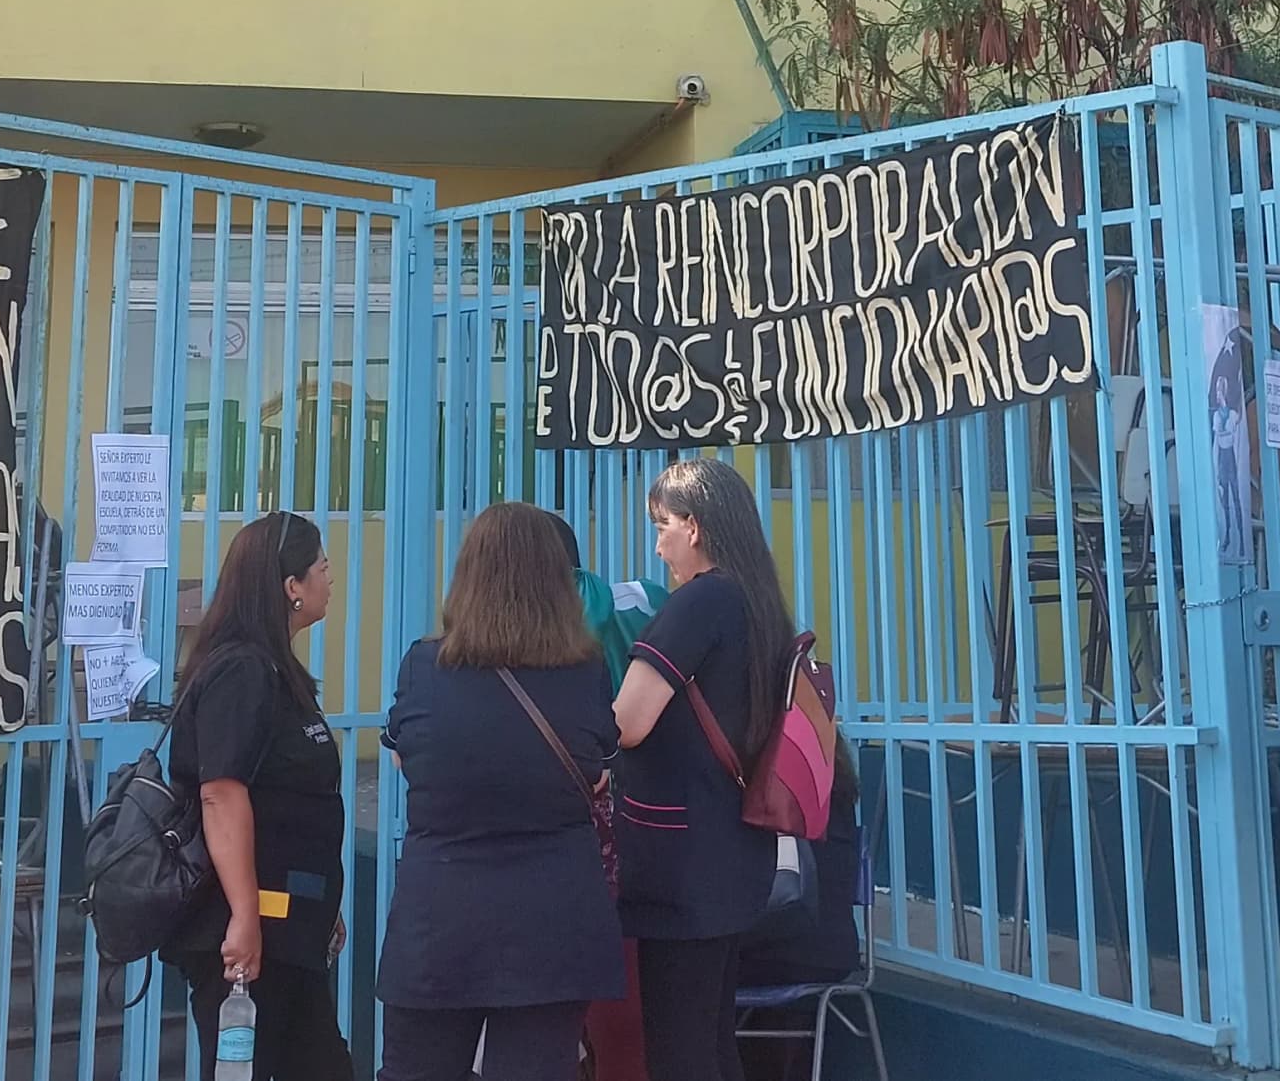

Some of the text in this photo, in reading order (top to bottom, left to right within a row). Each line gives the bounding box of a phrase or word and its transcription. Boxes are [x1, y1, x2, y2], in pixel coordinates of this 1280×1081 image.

[593, 204, 644, 325] LA
[753, 237, 1092, 445] FUNCIONARI@S
[69, 584, 134, 597] MENOS EXPERTOS
[68, 605, 123, 618] MAS DIGNIDAD
[89, 658, 101, 670] NO
